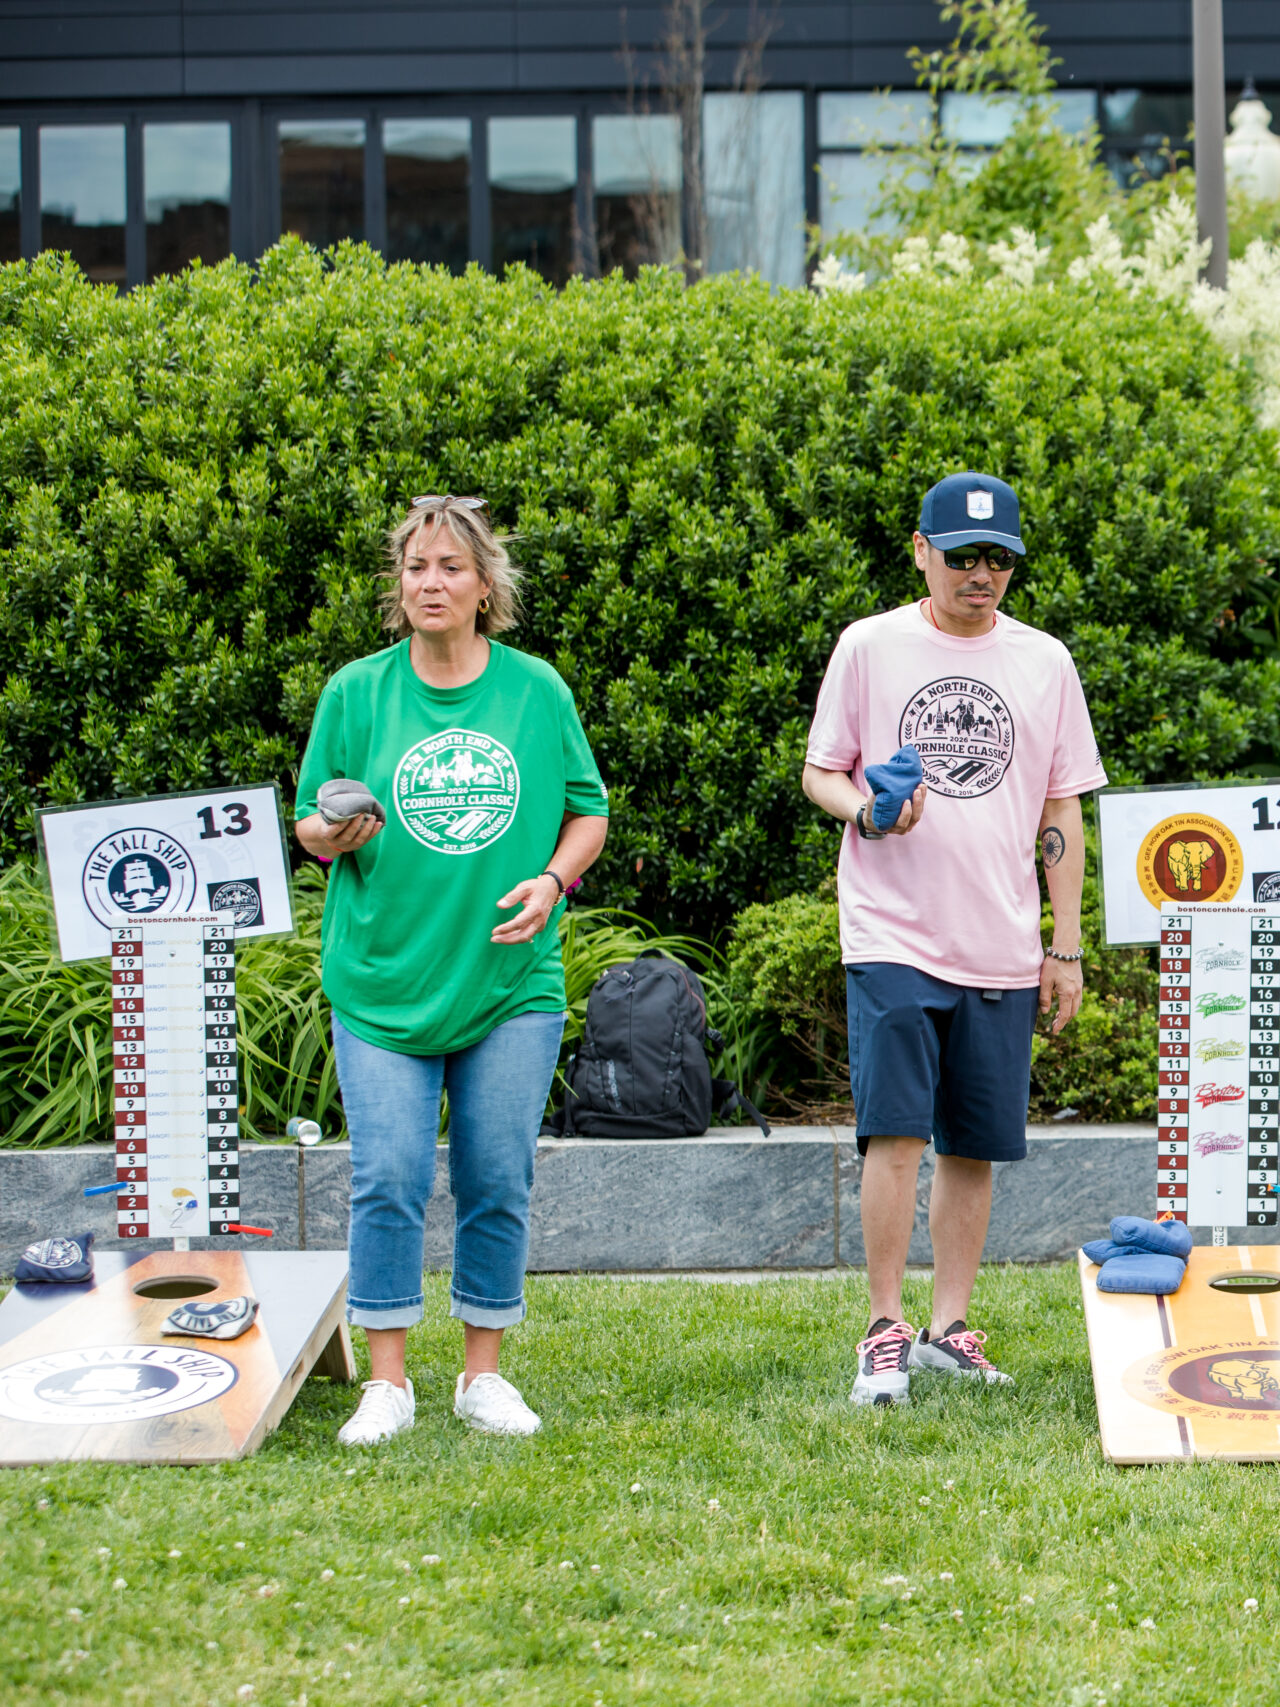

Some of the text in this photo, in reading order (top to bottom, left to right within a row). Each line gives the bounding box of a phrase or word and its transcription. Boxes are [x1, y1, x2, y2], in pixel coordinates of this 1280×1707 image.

[927, 682, 994, 702] NORTH END
[421, 734, 491, 754] NORTH END
[949, 735, 969, 743] 2026
[910, 743, 1008, 761] ORNHOLE CLASSIC
[402, 794, 514, 810] CORNHOLE CLASSIC
[197, 802, 252, 840] 13
[1144, 847, 1153, 861] GEE
[1150, 833, 1161, 846] HOW
[1160, 823, 1174, 834] OAK
[1174, 818, 1185, 827] TIN
[1186, 818, 1227, 838] ASSOCIATION
[88, 833, 187, 882] THE TALL SHIP
[127, 915, 218, 924] bostoncornhole.com
[1168, 918, 1181, 927] 21
[1259, 919, 1272, 928] 21
[118, 929, 132, 939] 21
[211, 927, 225, 937] 21
[1167, 932, 1183, 942] 20
[1258, 933, 1274, 943] 20
[118, 944, 134, 954] 20
[210, 942, 226, 952] 20
[1168, 947, 1183, 956] 19
[1259, 948, 1274, 957] 19
[120, 958, 135, 968] 19
[212, 956, 227, 966] 19
[1167, 960, 1182, 970] 18
[1258, 961, 1273, 971] 18
[119, 972, 135, 982] 18
[211, 970, 227, 980] 18
[1168, 975, 1182, 984] 17
[1259, 976, 1273, 985] 17
[120, 986, 135, 996] 17
[213, 984, 227, 994] 17
[1167, 988, 1182, 998] 16
[1258, 989, 1273, 999] 16
[212, 998, 227, 1008] 16
[1195, 992, 1244, 1006] Boston
[120, 1000, 135, 1010] 16
[1168, 1003, 1182, 1012] 15
[1259, 1004, 1273, 1013] 15
[122, 1015, 136, 1024] 15
[214, 1012, 229, 1022] 15
[1167, 1017, 1182, 1026] 14
[1258, 1017, 1273, 1027] 14
[121, 1029, 137, 1038] 14
[213, 1026, 229, 1036] 14
[1168, 1031, 1182, 1041] 13
[1259, 1032, 1273, 1041] 13
[122, 1043, 137, 1052] 13
[215, 1041, 229, 1050] 13
[1167, 1045, 1182, 1054] 12
[1258, 1045, 1273, 1055] 12
[122, 1056, 138, 1066] 12
[214, 1054, 230, 1064] 12
[1167, 1059, 1180, 1069] 11
[1258, 1060, 1271, 1069] 11
[123, 1071, 136, 1080] 11
[215, 1069, 229, 1078] 11
[1167, 1073, 1182, 1082] 10
[1258, 1073, 1273, 1083] 10
[122, 1084, 138, 1094] 10
[215, 1082, 231, 1092] 10
[1170, 1087, 1178, 1097] 9
[1193, 1083, 1243, 1097] Boston
[1261, 1088, 1269, 1097] 9
[127, 1099, 134, 1109] 9
[219, 1097, 227, 1107] 9
[1170, 1101, 1177, 1111] 8
[1260, 1101, 1268, 1111] 8
[127, 1113, 135, 1123] 8
[219, 1111, 227, 1120] 8
[1170, 1115, 1177, 1125] 7
[1260, 1116, 1268, 1125] 7
[127, 1127, 135, 1137] 7
[219, 1125, 227, 1135] 7
[1169, 1129, 1177, 1139] 6
[1260, 1130, 1268, 1140] 6
[1193, 1132, 1242, 1145] Boston
[127, 1141, 136, 1151] 6
[219, 1139, 228, 1149] 6
[1169, 1143, 1177, 1153] 5
[1260, 1144, 1267, 1154] 5
[128, 1156, 135, 1165] 5
[220, 1153, 228, 1163] 5
[1169, 1157, 1177, 1167] 4
[1259, 1158, 1267, 1168] 4
[128, 1169, 136, 1179] 4
[220, 1167, 228, 1177] 4
[1169, 1171, 1176, 1181] 3
[1260, 1172, 1267, 1182] 3
[129, 1184, 136, 1193] 3
[221, 1181, 228, 1191] 3
[1168, 1185, 1176, 1195] 2
[1258, 1186, 1266, 1195] 2
[128, 1197, 136, 1207] 2
[220, 1195, 228, 1205] 2
[1169, 1200, 1175, 1209] 1
[1260, 1200, 1265, 1210] 1
[130, 1212, 136, 1221] 1
[222, 1209, 228, 1219] 1
[1258, 1214, 1266, 1224] 0
[128, 1225, 137, 1235] 0
[220, 1223, 229, 1233] 0
[1158, 1351, 1187, 1363] HOW
[1187, 1343, 1222, 1354] OAK
[1226, 1340, 1252, 1349] TIN
[1, 1349, 225, 1380] THE TALL SHIP
